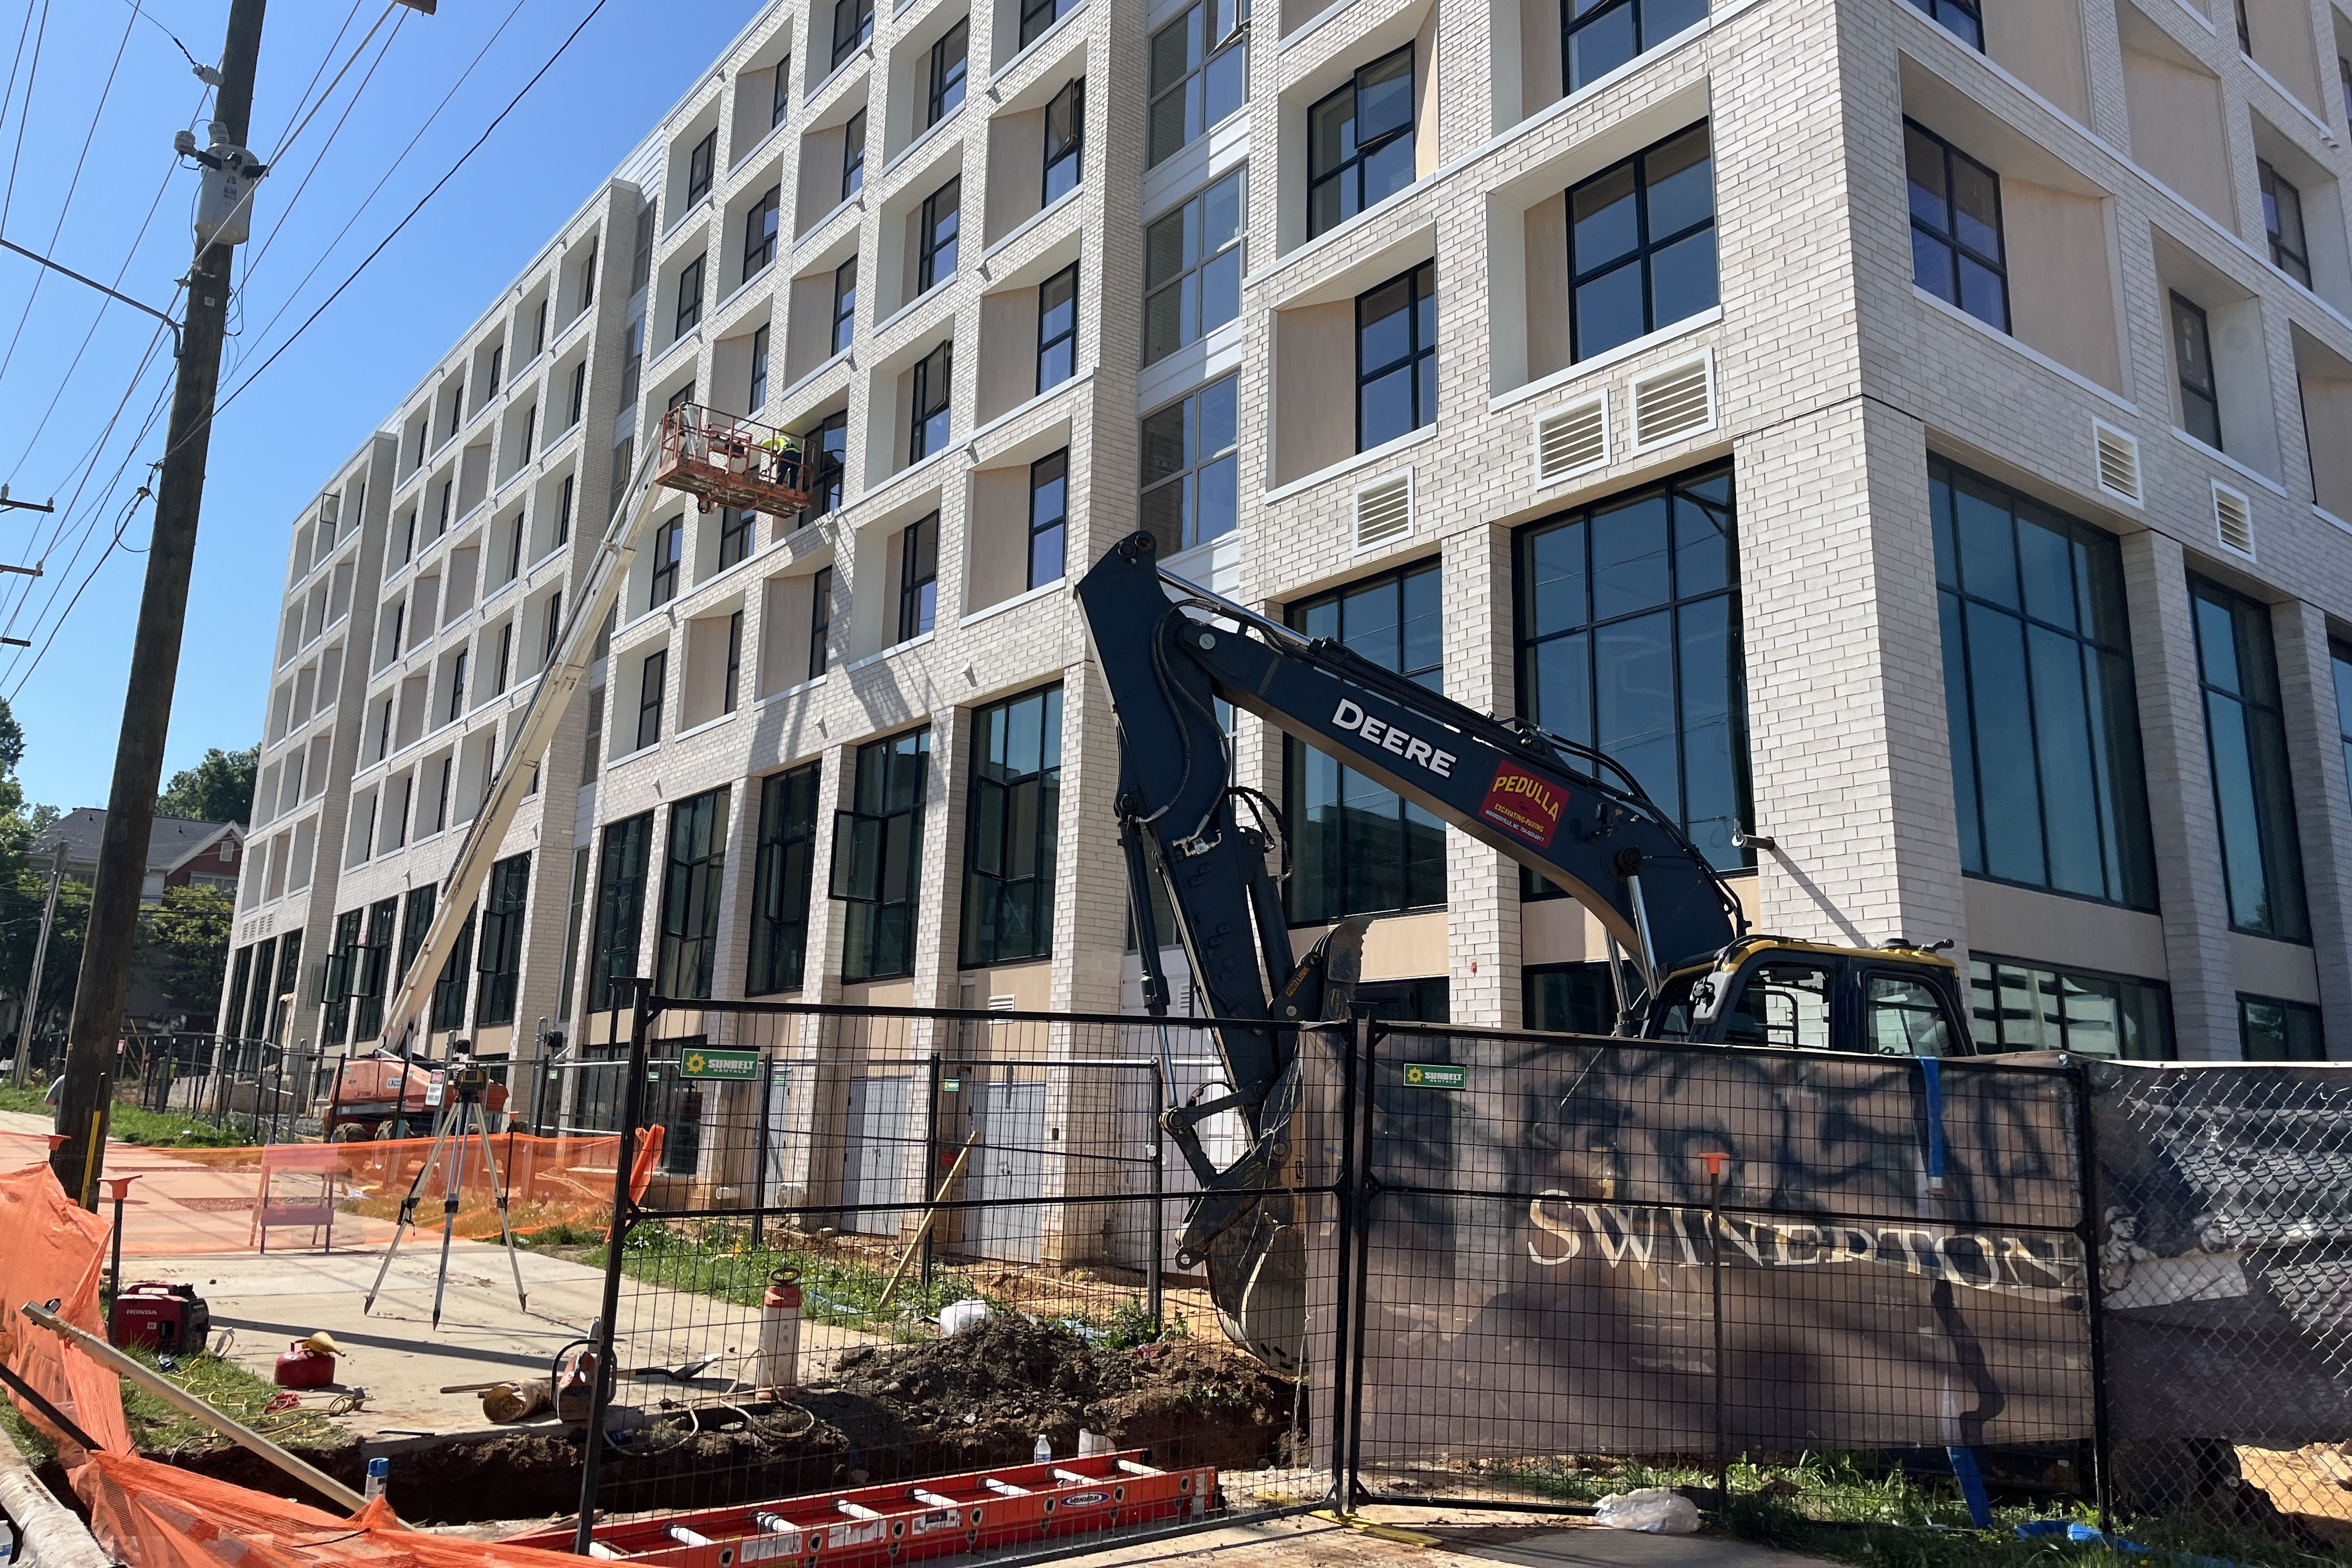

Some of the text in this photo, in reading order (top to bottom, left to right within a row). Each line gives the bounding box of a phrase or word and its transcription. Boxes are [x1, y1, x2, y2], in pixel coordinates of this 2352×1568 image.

[1332, 698, 1457, 778] DEERE
[1492, 776, 1559, 822] PEDULLA
[708, 1059, 755, 1070] SUNBELT
[1424, 1072, 1462, 1081] SUNBELT
